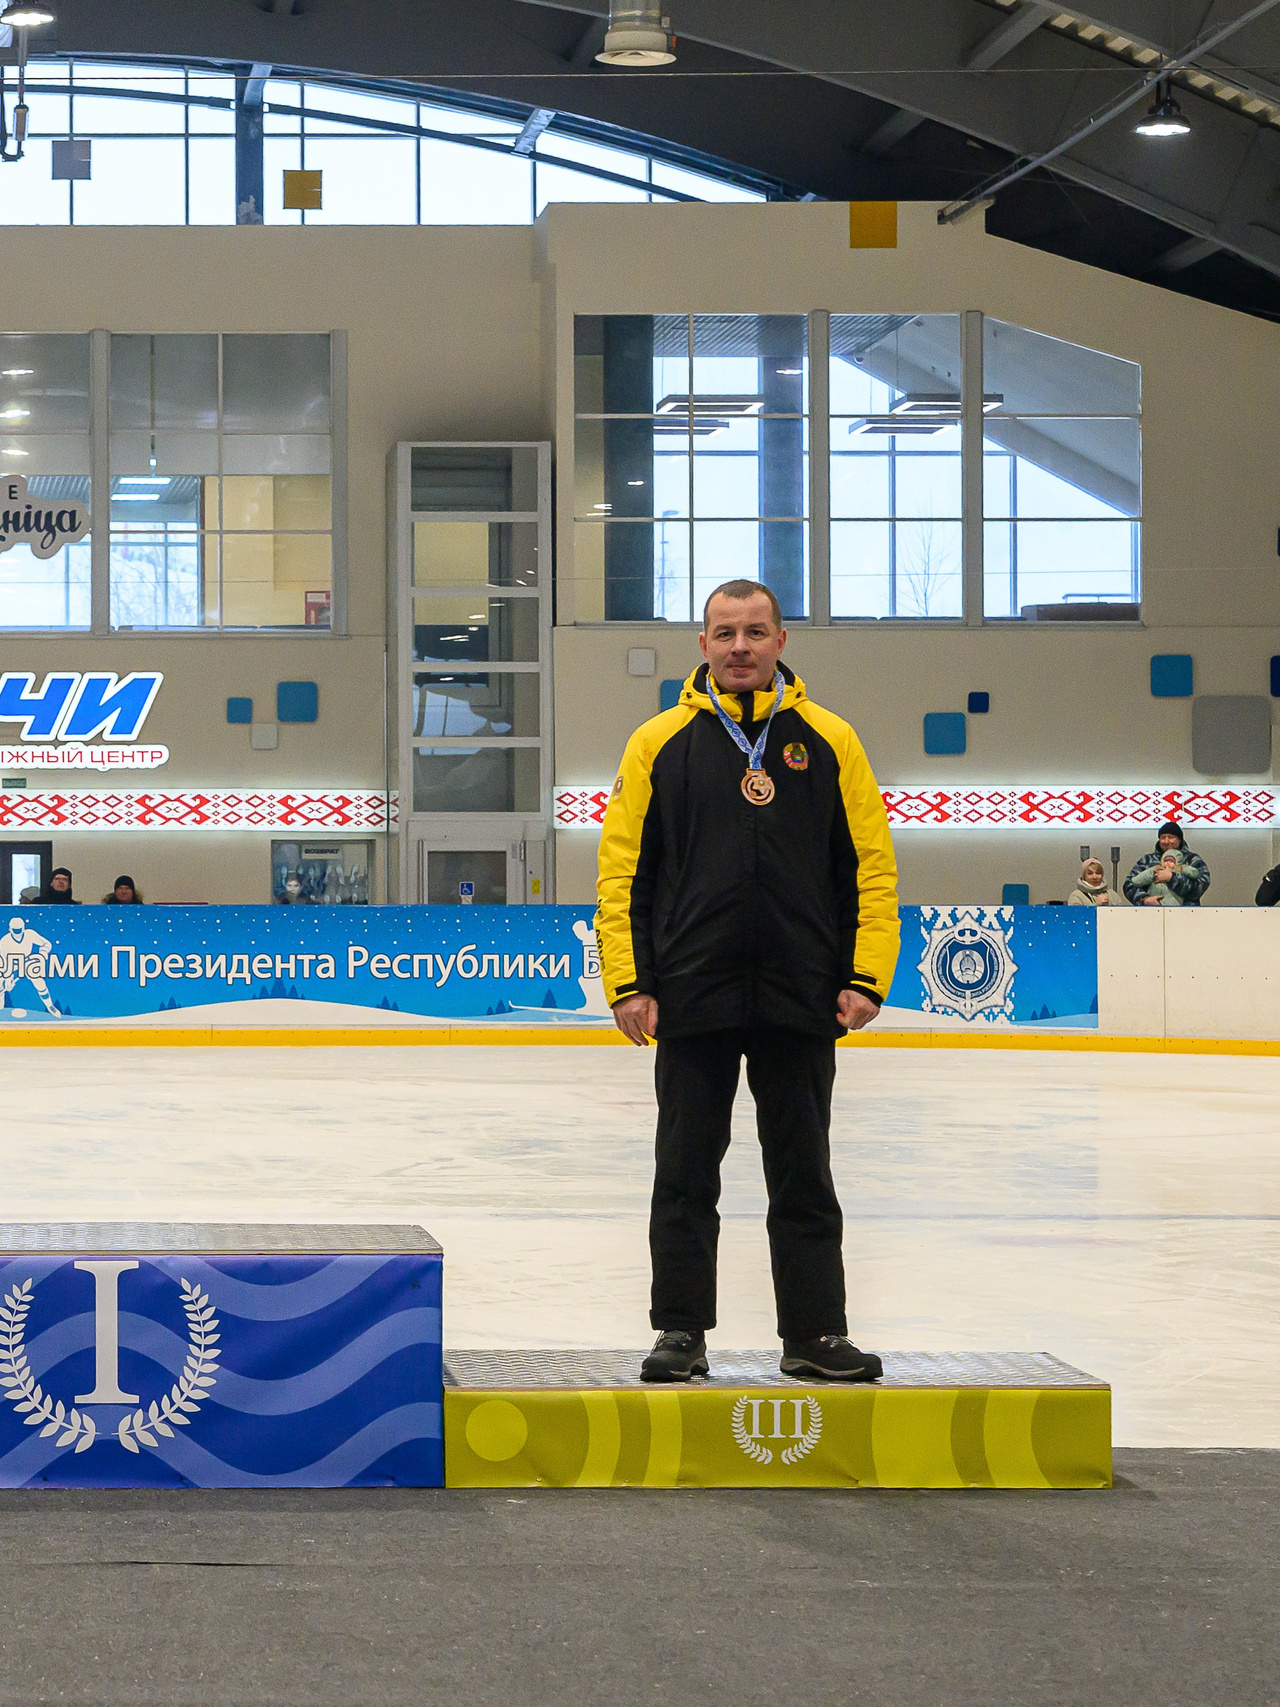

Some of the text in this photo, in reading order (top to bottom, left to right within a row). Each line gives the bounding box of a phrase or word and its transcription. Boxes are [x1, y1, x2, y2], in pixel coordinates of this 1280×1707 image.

[89, 750, 164, 768] ЦЕНТР
[110, 944, 336, 987] Президента
[346, 943, 571, 988] Республики
[73, 1260, 140, 1404] I
[746, 1399, 808, 1438] III
